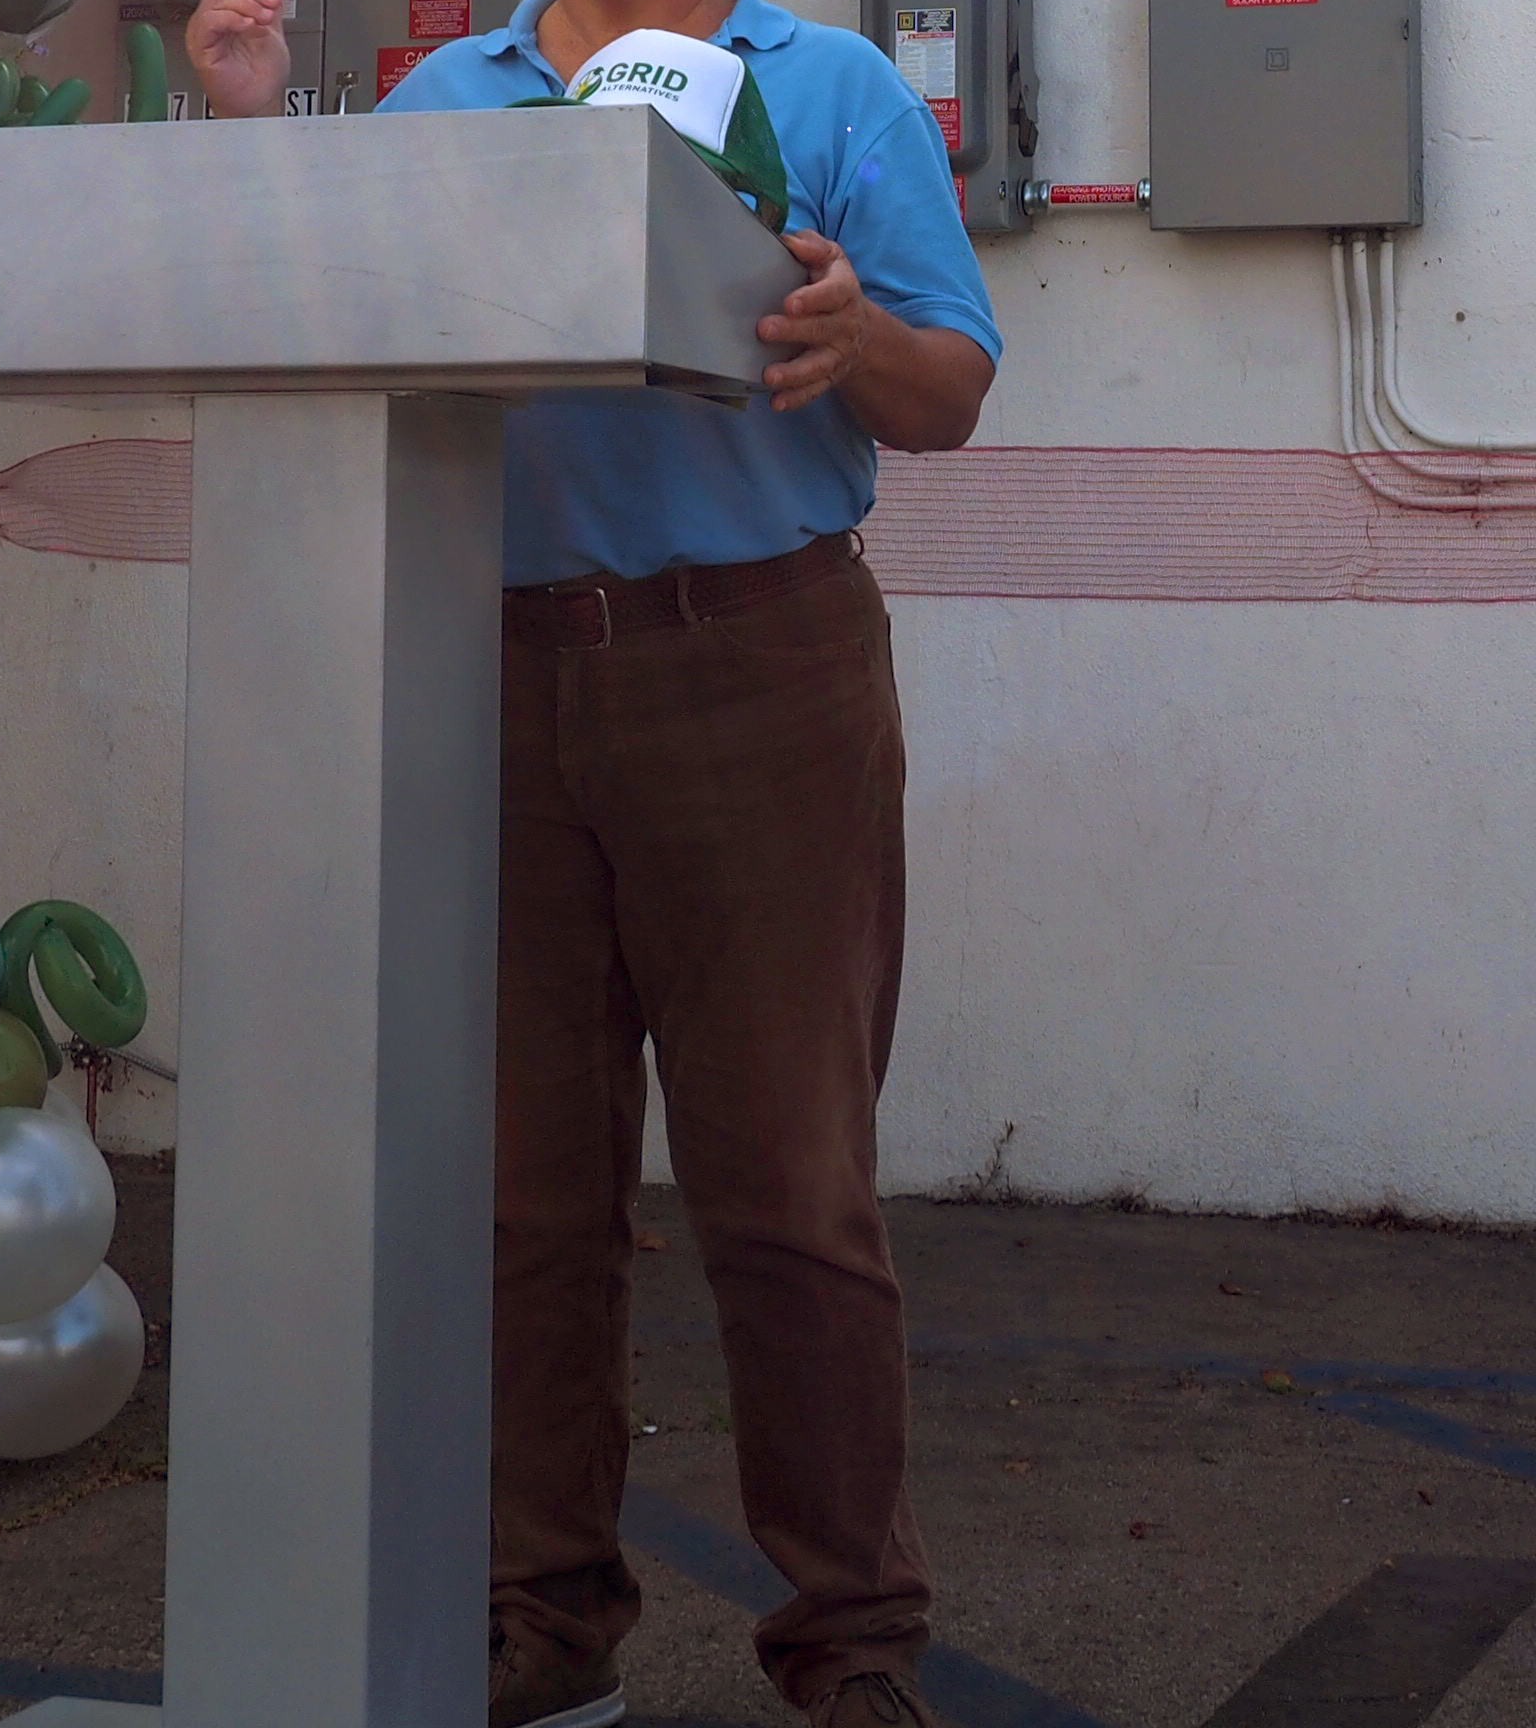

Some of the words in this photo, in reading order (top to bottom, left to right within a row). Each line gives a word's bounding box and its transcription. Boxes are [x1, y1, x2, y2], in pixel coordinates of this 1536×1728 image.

[405, 52, 429, 65] CA
[606, 62, 688, 92] GRID
[601, 83, 680, 102] ALTERNATIVES
[287, 89, 316, 117] ST
[1069, 194, 1097, 202] POWER
[1099, 193, 1130, 202] SOURCE
